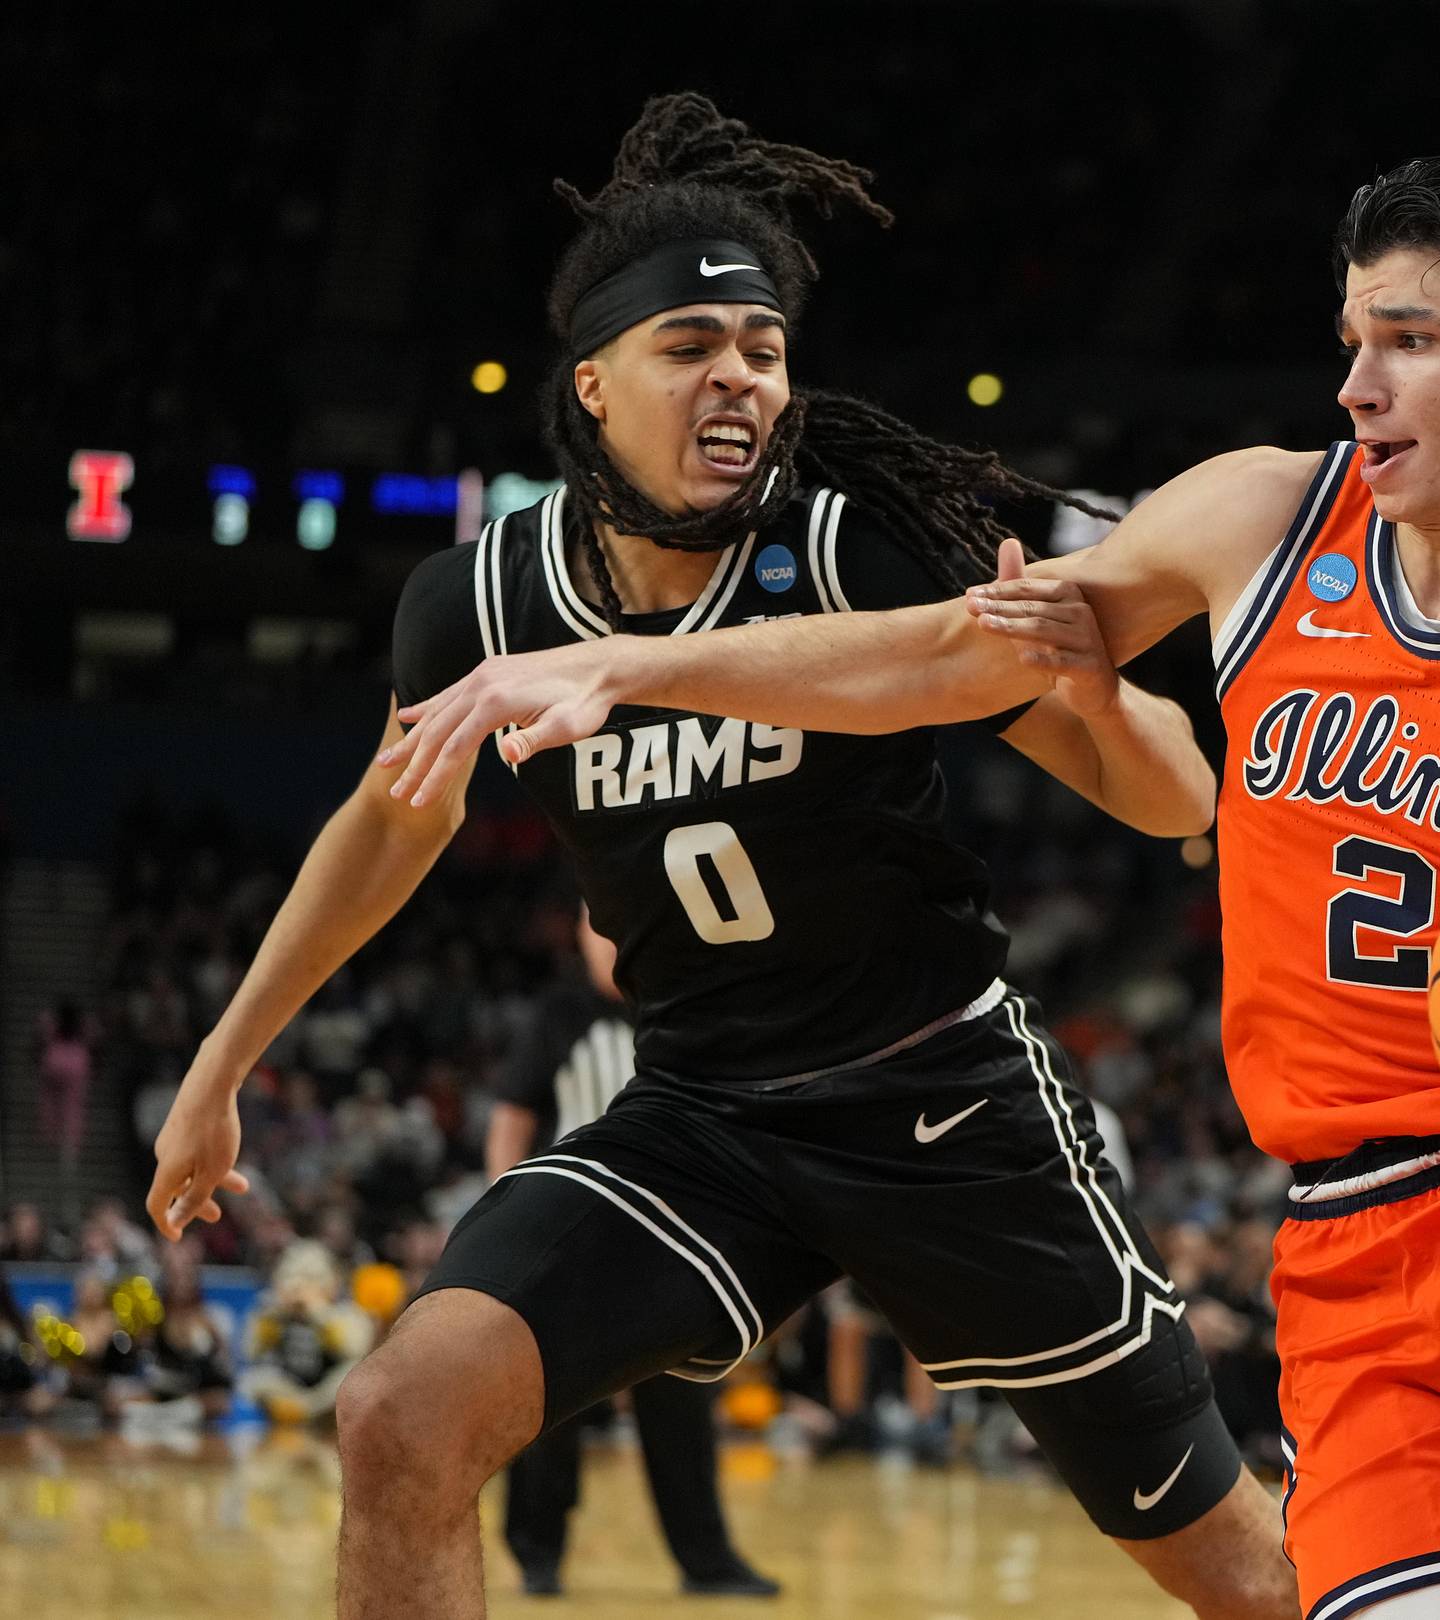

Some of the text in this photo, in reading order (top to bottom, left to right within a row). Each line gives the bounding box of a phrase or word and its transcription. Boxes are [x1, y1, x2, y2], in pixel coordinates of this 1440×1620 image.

[761, 566, 795, 581] NCAA
[1311, 570, 1350, 595] NCAA
[572, 717, 803, 812] RAMS
[663, 821, 775, 945] 0
[1325, 833, 1434, 991] 2
